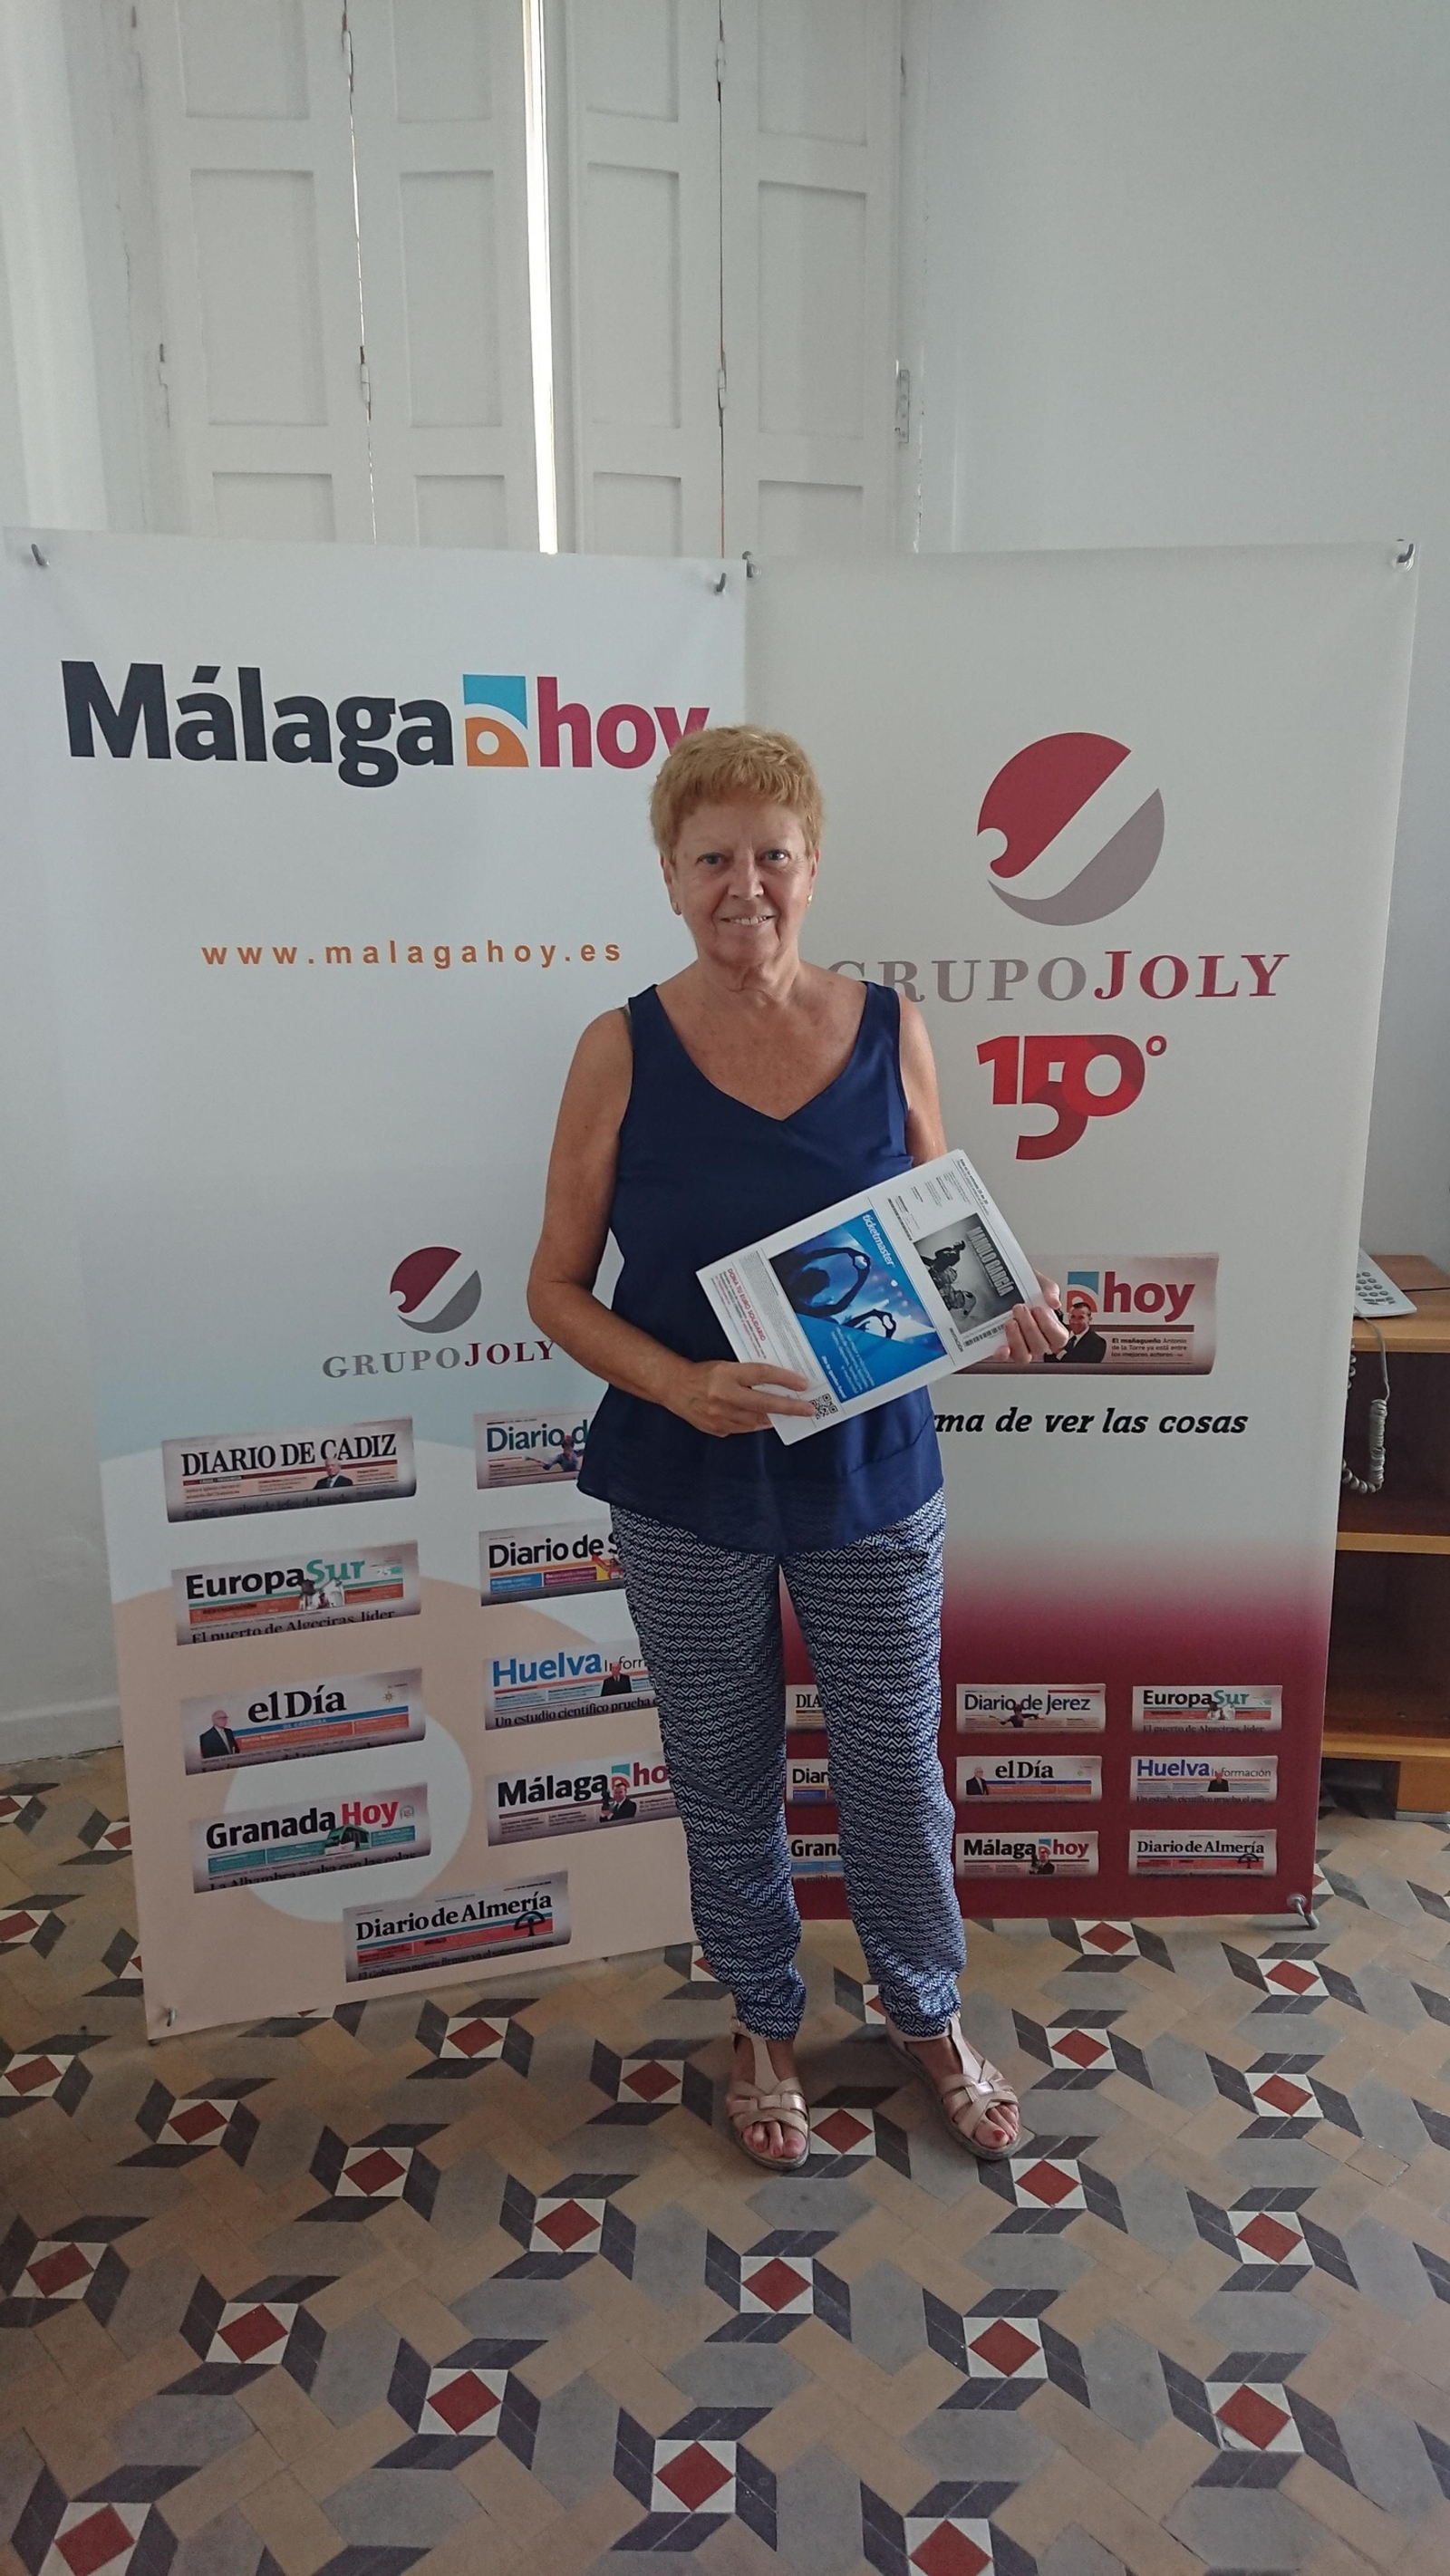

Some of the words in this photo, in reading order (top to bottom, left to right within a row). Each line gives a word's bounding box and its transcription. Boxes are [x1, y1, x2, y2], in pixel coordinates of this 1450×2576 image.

[62, 660, 454, 787] Málaga
[201, 940, 622, 970] www.malagahoy.es
[860, 1212, 896, 1268] ticketmaster
[965, 1224, 997, 1264] MANOLO
[983, 1257, 1016, 1297] GARCÍA
[1102, 1271, 1196, 1323] hoy
[487, 1423, 565, 1452] Diario
[572, 1419, 589, 1445] d
[933, 1413, 985, 1432] ma
[995, 1406, 1032, 1433] de
[1045, 1414, 1096, 1433] ver
[1102, 1408, 1149, 1433] las
[1158, 1413, 1250, 1434] cosas
[181, 1445, 276, 1476] DIARIO
[281, 1441, 315, 1466] DE
[489, 1538, 569, 1568] Diario
[573, 1534, 604, 1559] de
[493, 1652, 602, 1687] Huelva
[514, 1707, 556, 1725] estudio
[611, 1697, 651, 1713] prueba
[796, 1694, 822, 1709] DIA
[964, 1693, 1016, 1711] Diario
[1020, 1693, 1043, 1712] de
[1046, 1693, 1091, 1715] Jerez
[792, 1769, 829, 1784] Diar
[1137, 1759, 1210, 1777] Huelva
[498, 1773, 608, 1808] Málaga
[633, 1762, 670, 1788] ho
[206, 1808, 335, 1850] Granada
[342, 1801, 400, 1828] Hoy
[791, 1839, 837, 1857] Gran
[963, 1838, 1036, 1859] Málaga
[1053, 1839, 1090, 1858] hoy
[1136, 1841, 1184, 1854] Diario
[1185, 1840, 1204, 1854] de
[1204, 1840, 1265, 1855] Almería
[355, 1913, 430, 1941] Diario
[431, 1907, 459, 1928] de
[462, 1891, 553, 1922] Almería
